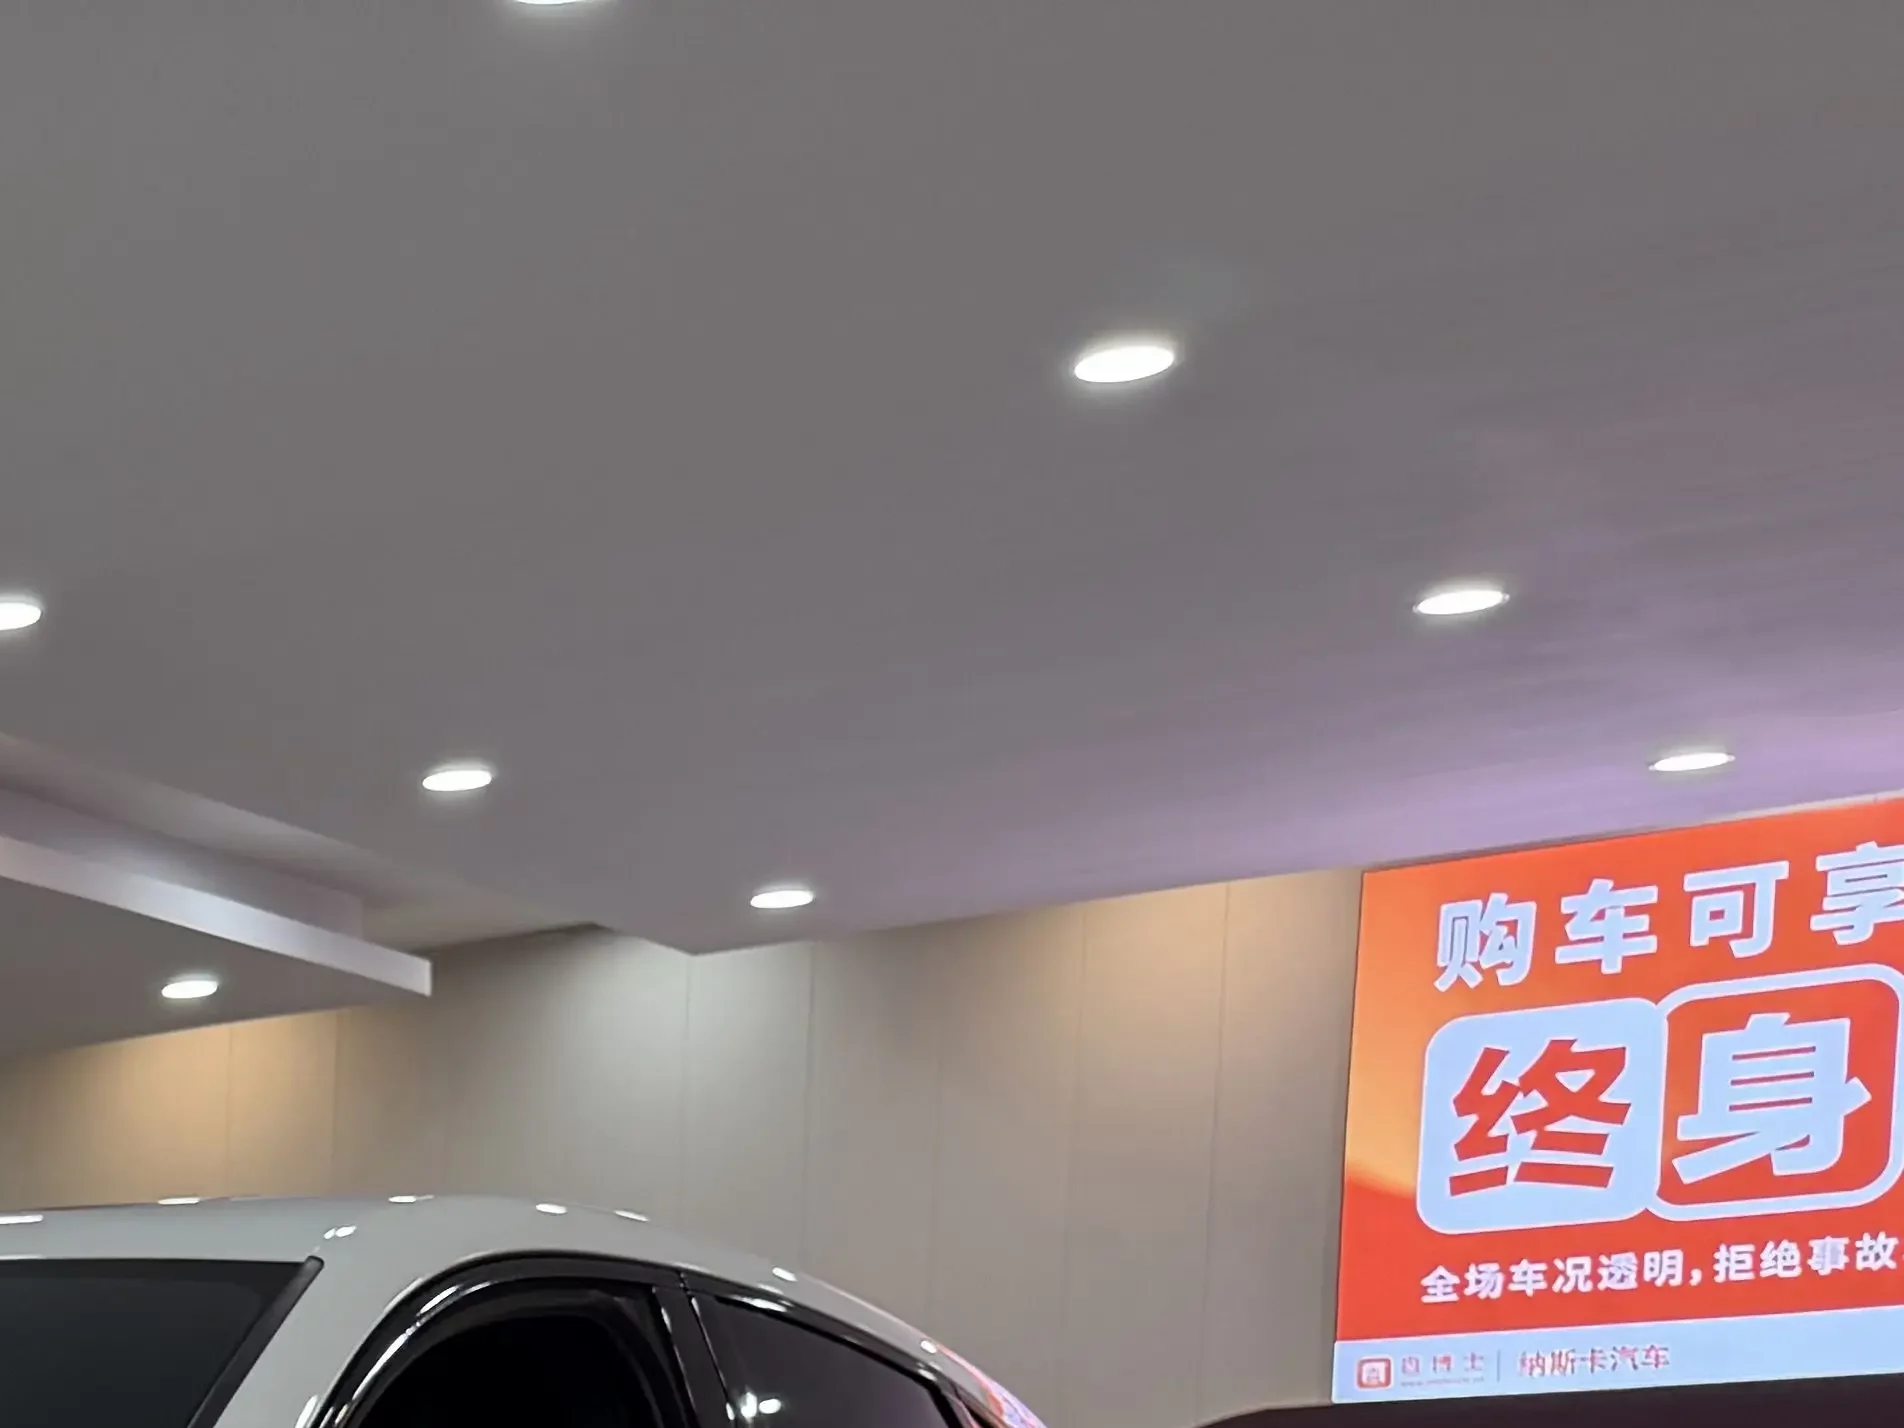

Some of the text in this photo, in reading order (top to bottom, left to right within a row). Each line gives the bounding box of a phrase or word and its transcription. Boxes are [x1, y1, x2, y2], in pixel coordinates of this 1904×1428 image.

[1432, 841, 1904, 993] 购车可享
[1449, 1011, 1873, 1198] 终身
[1519, 1344, 1669, 1377] 纳斯卡汽车
